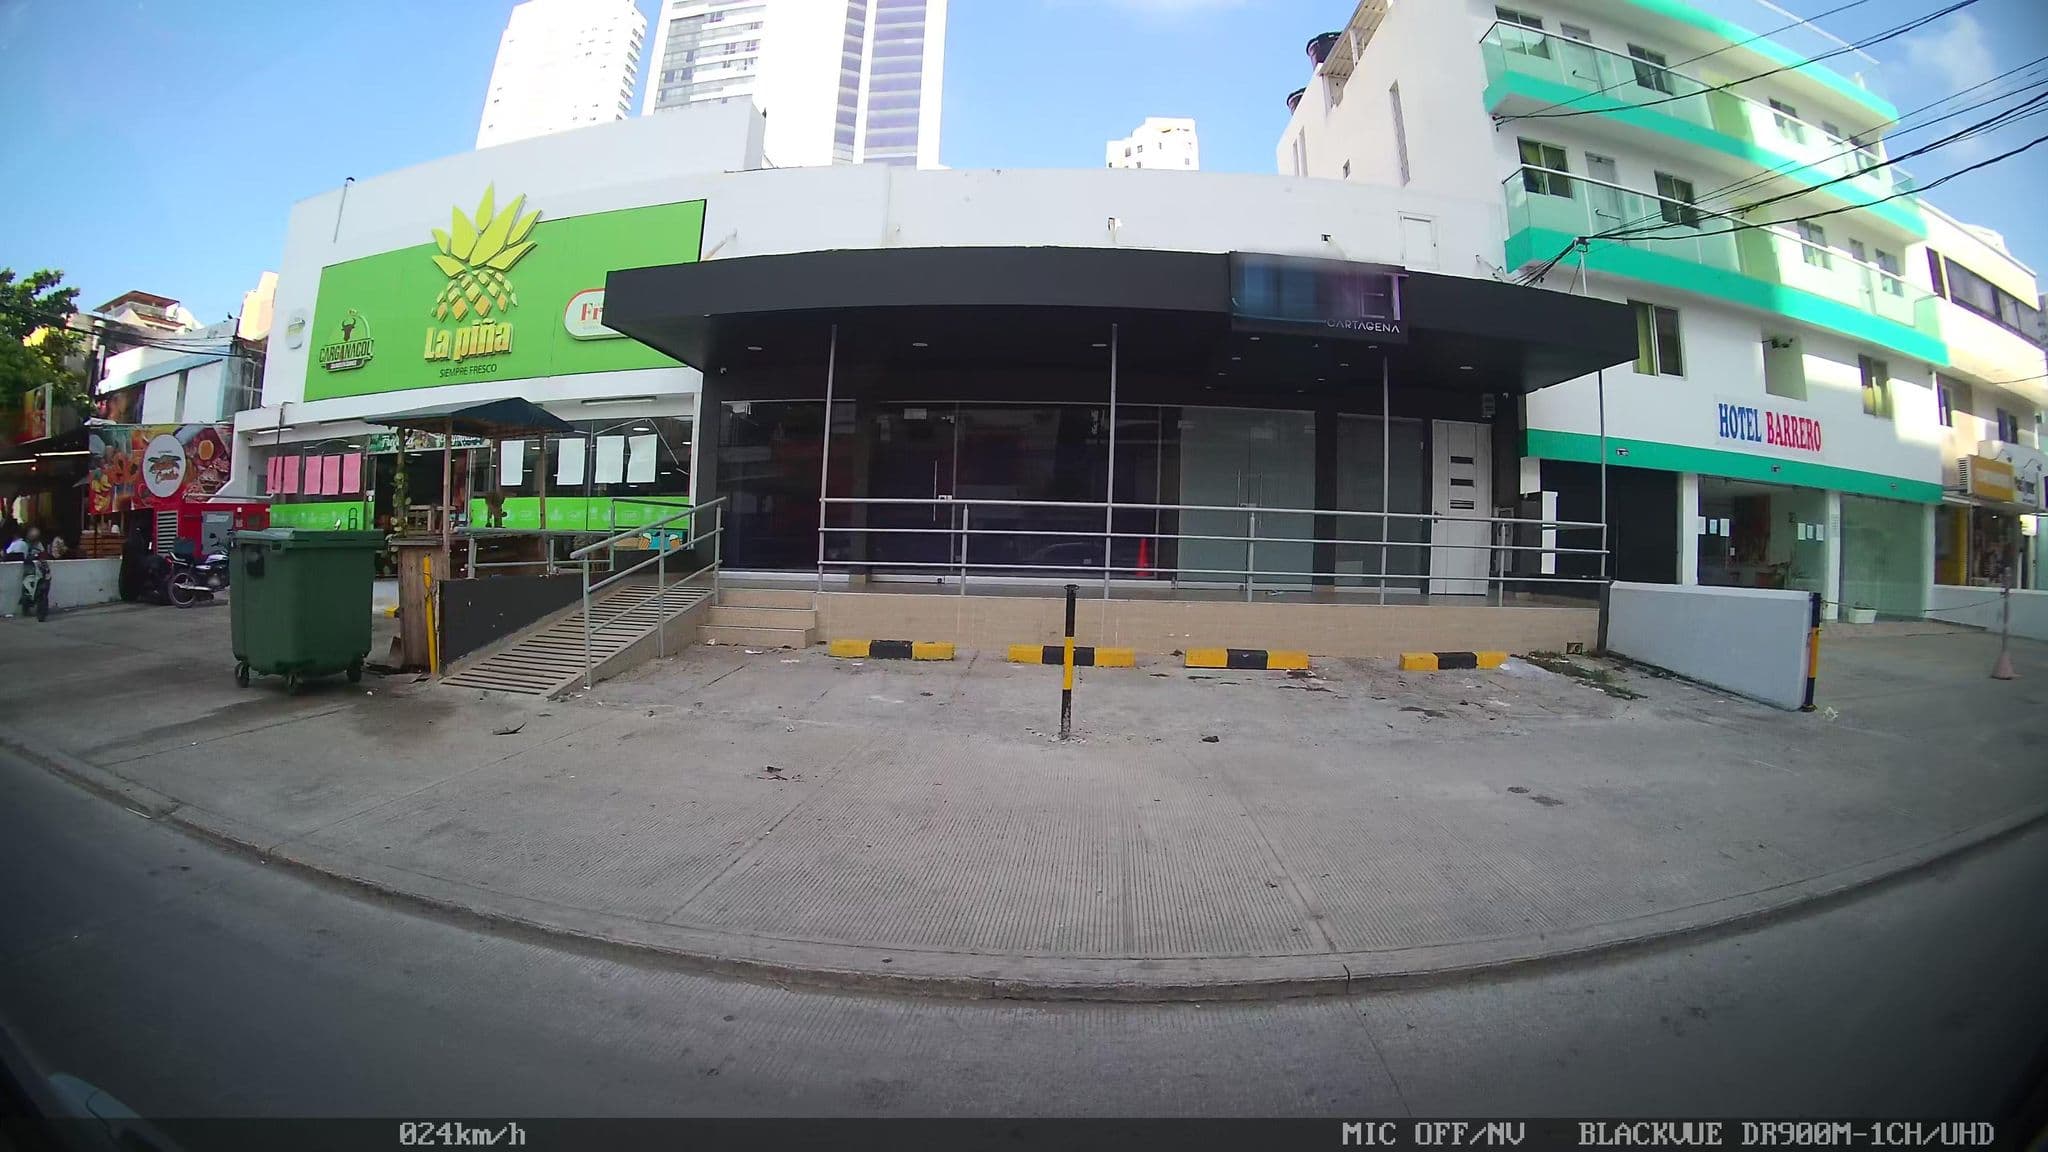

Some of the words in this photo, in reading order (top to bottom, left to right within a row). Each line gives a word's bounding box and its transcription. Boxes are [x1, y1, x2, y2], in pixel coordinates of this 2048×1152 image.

[424, 327, 451, 361] La
[453, 317, 513, 362] piña
[1327, 319, 1400, 334] CARTAGENA
[439, 365, 468, 378] SIEMPRE
[469, 363, 497, 376] FRESCO
[1718, 403, 1762, 443] HOTEL
[1765, 411, 1822, 452] BARRERO
